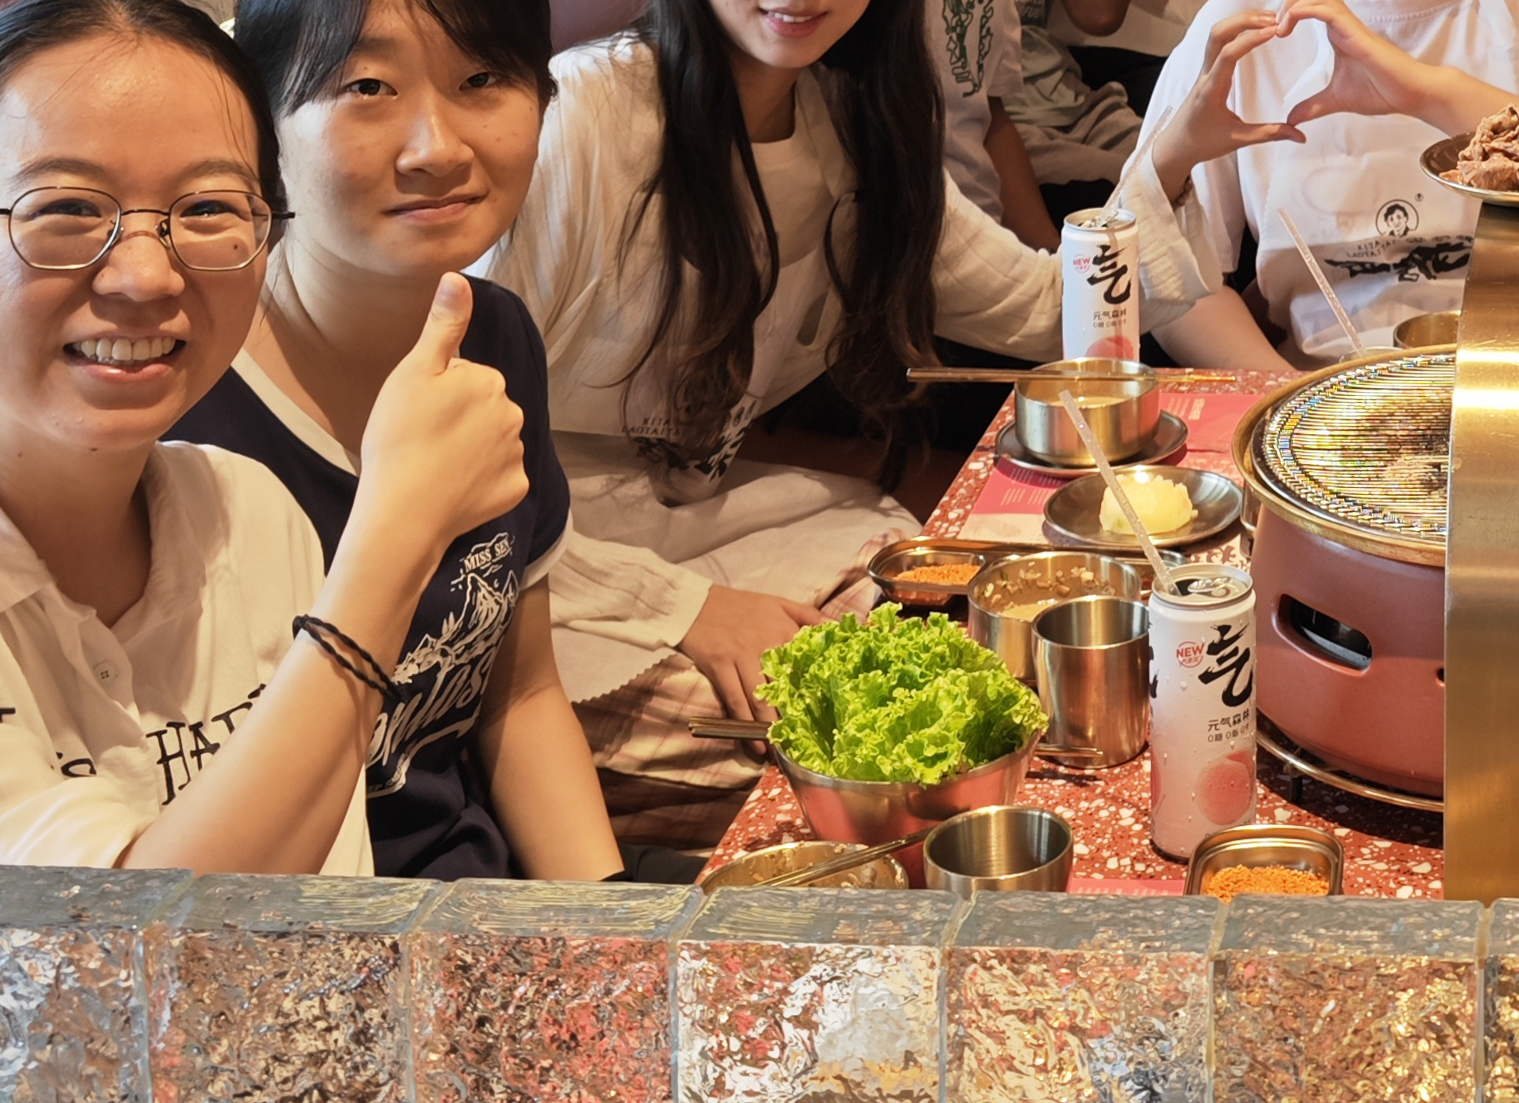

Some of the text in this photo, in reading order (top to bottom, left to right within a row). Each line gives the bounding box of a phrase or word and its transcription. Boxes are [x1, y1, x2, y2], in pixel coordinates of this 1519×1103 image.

[1073, 257, 1091, 266] NEW
[463, 548, 491, 573] MISS
[1176, 642, 1205, 659] NEW
[1207, 708, 1250, 732] 元气森林
